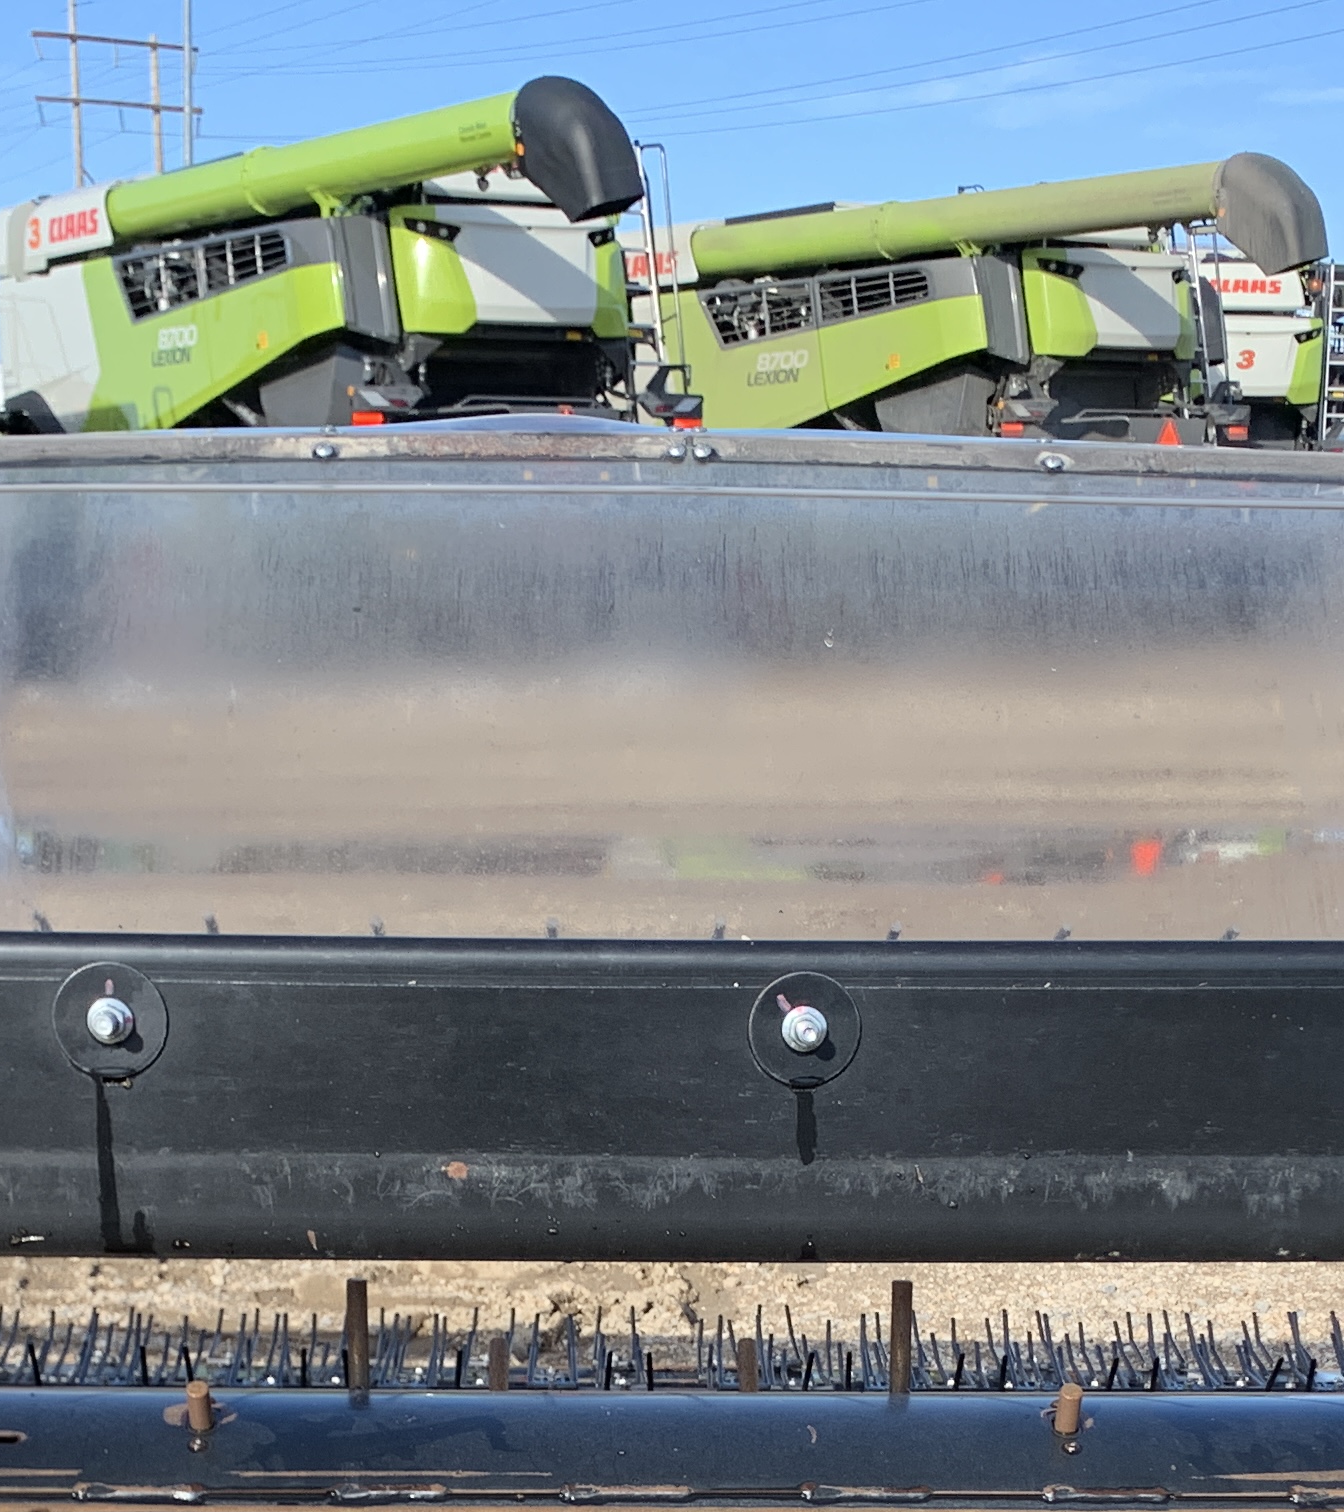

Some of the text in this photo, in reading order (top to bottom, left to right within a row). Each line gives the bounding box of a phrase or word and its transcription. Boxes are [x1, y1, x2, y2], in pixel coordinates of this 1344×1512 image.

[29, 207, 99, 250] 3 CLAAS
[151, 347, 190, 367] LEXION
[757, 350, 808, 371] 8700
[1236, 349, 1256, 370] 3
[747, 367, 799, 387] LEXION
